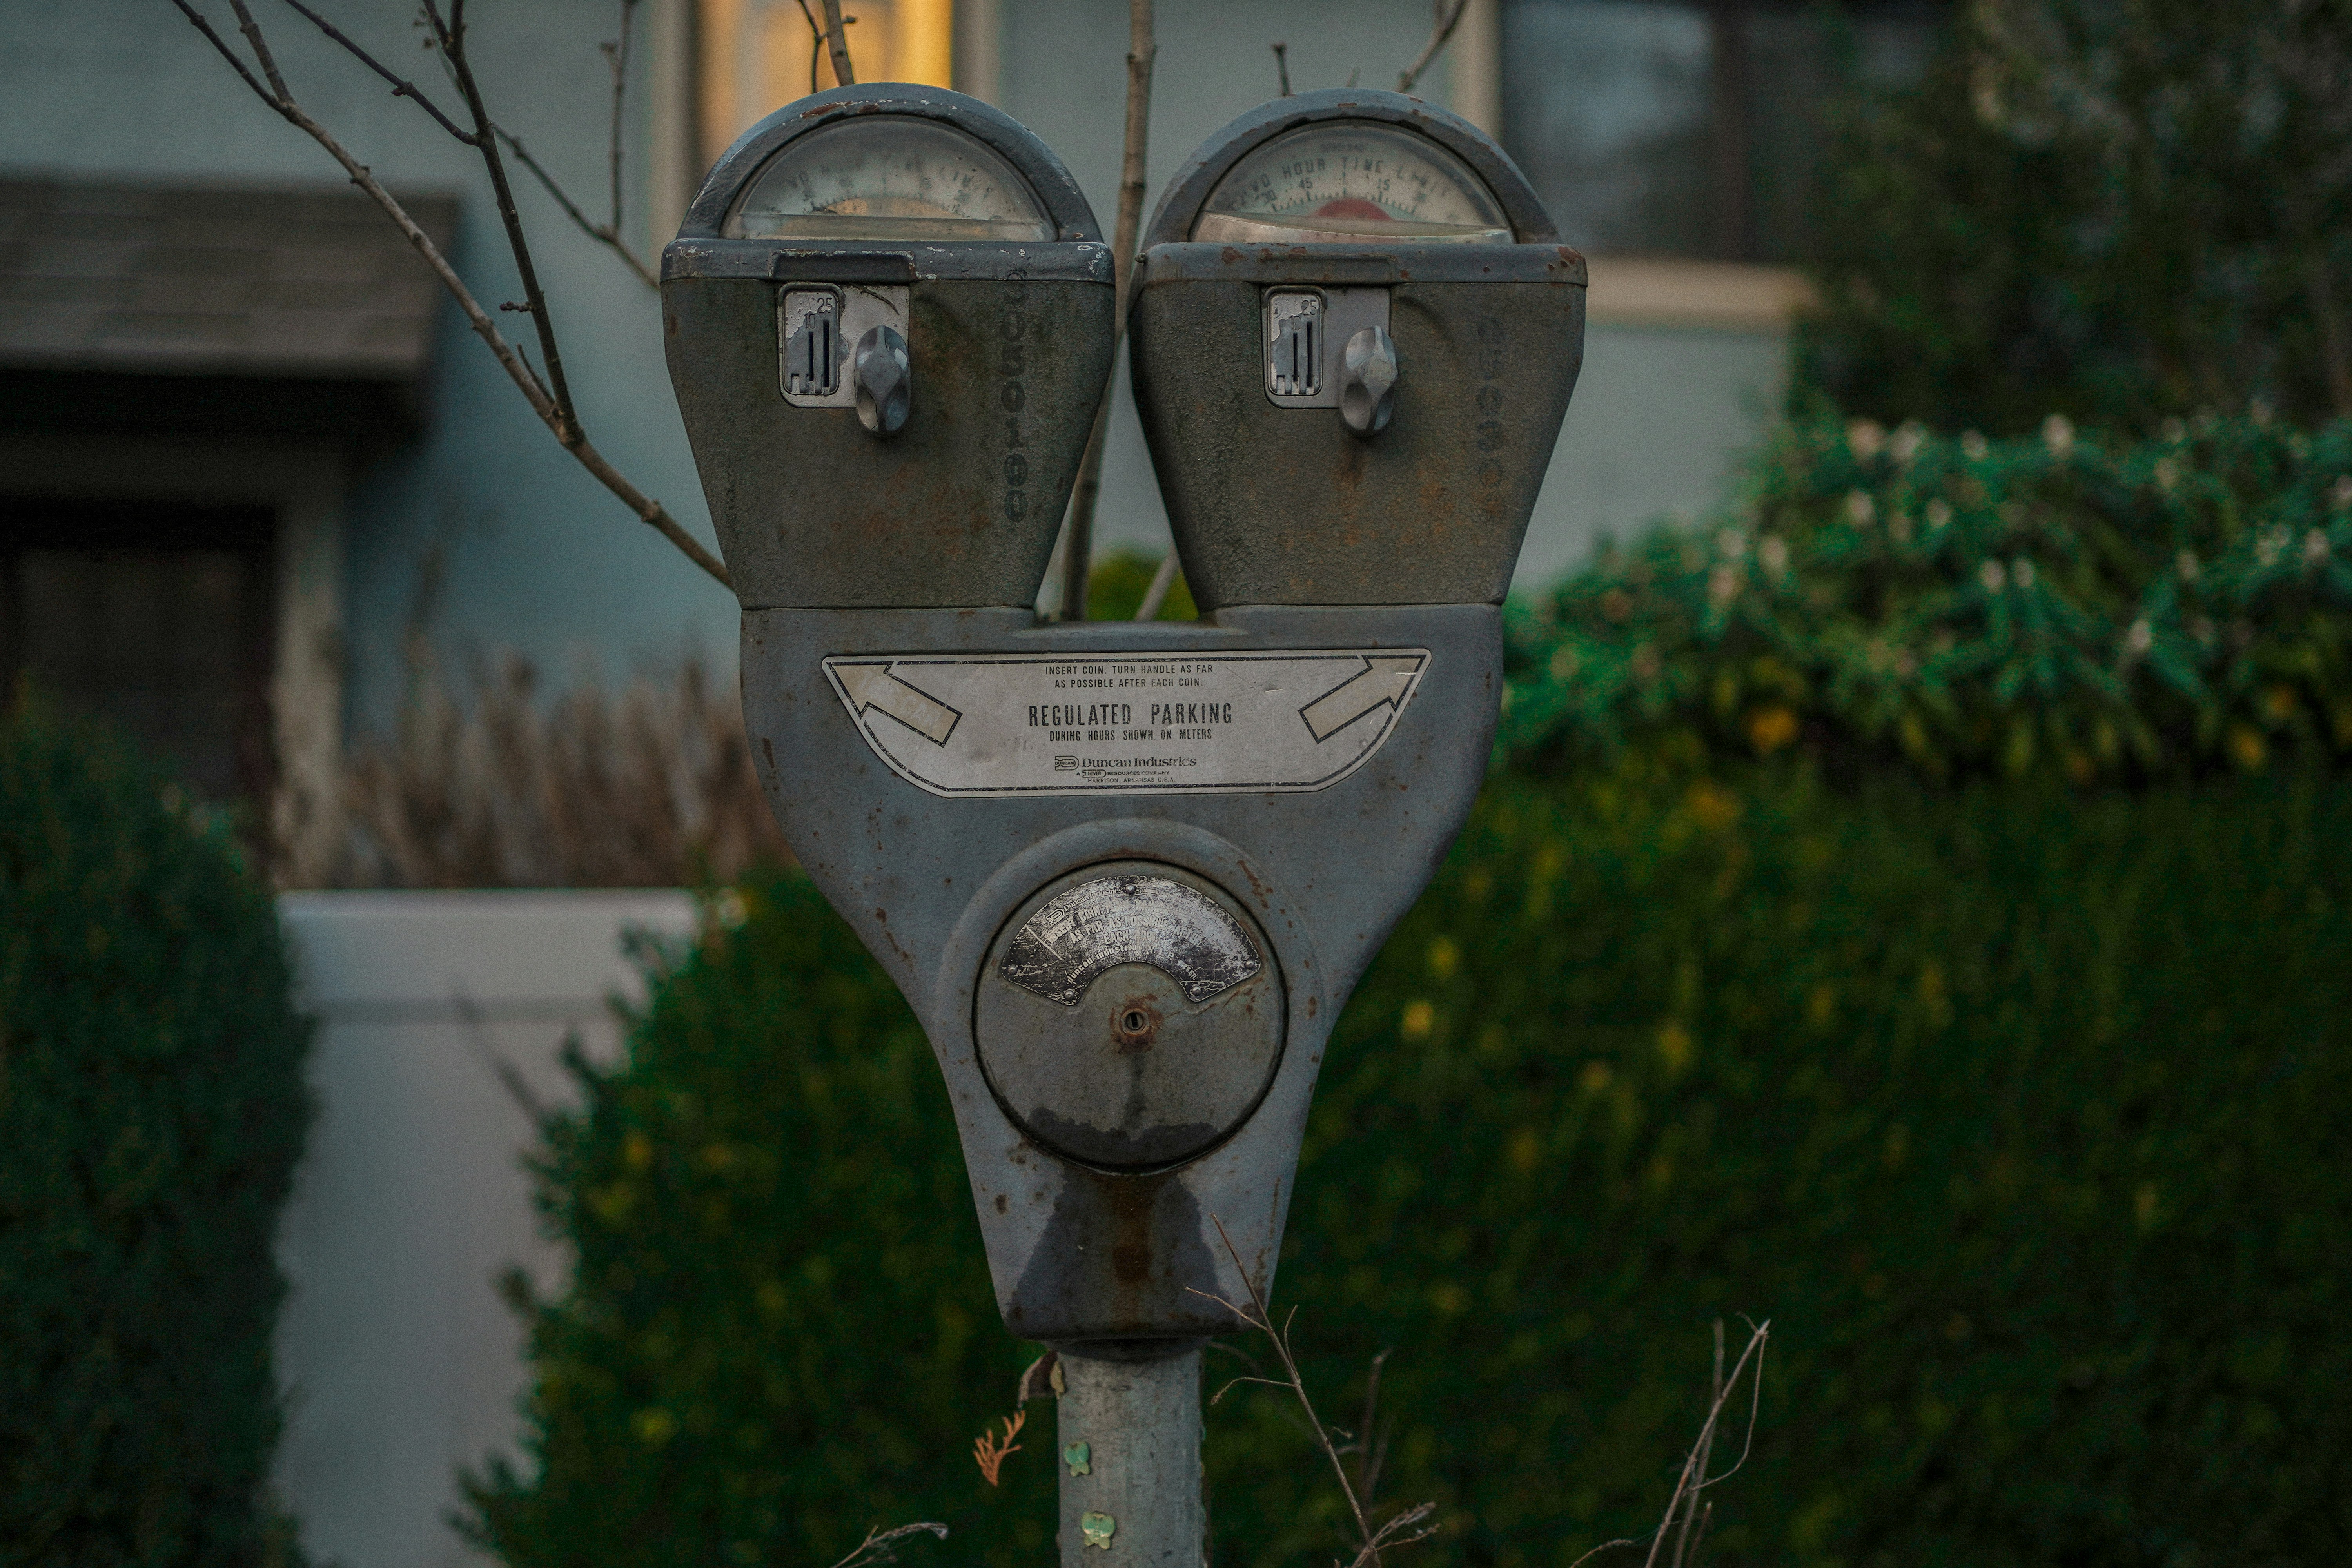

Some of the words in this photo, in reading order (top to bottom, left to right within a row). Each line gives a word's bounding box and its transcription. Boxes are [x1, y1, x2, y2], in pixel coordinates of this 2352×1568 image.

[1282, 158, 1326, 178] HOUR
[1342, 156, 1383, 173] TIME
[1299, 177, 1313, 189] 45
[1377, 178, 1390, 191] 15
[817, 298, 832, 313] 25
[1301, 299, 1317, 316] 25
[804, 311, 816, 329] 10
[1045, 666, 1077, 675] INSERT
[1083, 666, 1107, 674] COIN.
[1112, 666, 1136, 674] TURN
[1141, 665, 1175, 673] HANDLE
[1181, 665, 1191, 673] AS
[1196, 664, 1213, 673] FAR
[1055, 679, 1065, 688] AS
[1071, 679, 1113, 688] POSSIBLE
[1118, 679, 1146, 687] AFTER
[1151, 678, 1173, 686] EACH
[1029, 704, 1131, 726] REGULATED
[1151, 703, 1232, 724] PARKING
[1050, 730, 1080, 741] DURING
[1088, 730, 1115, 741] HOURS
[1123, 729, 1154, 740] SHOWN
[1161, 729, 1172, 740] ON
[1179, 728, 1212, 739] METERS
[1082, 758, 1132, 767] Duncan
[1134, 756, 1197, 767] Industries
[1064, 895, 1090, 911] Duncan
[1069, 929, 1084, 944] AS
[1084, 920, 1104, 936] FAR
[1067, 957, 1093, 984] duncan
